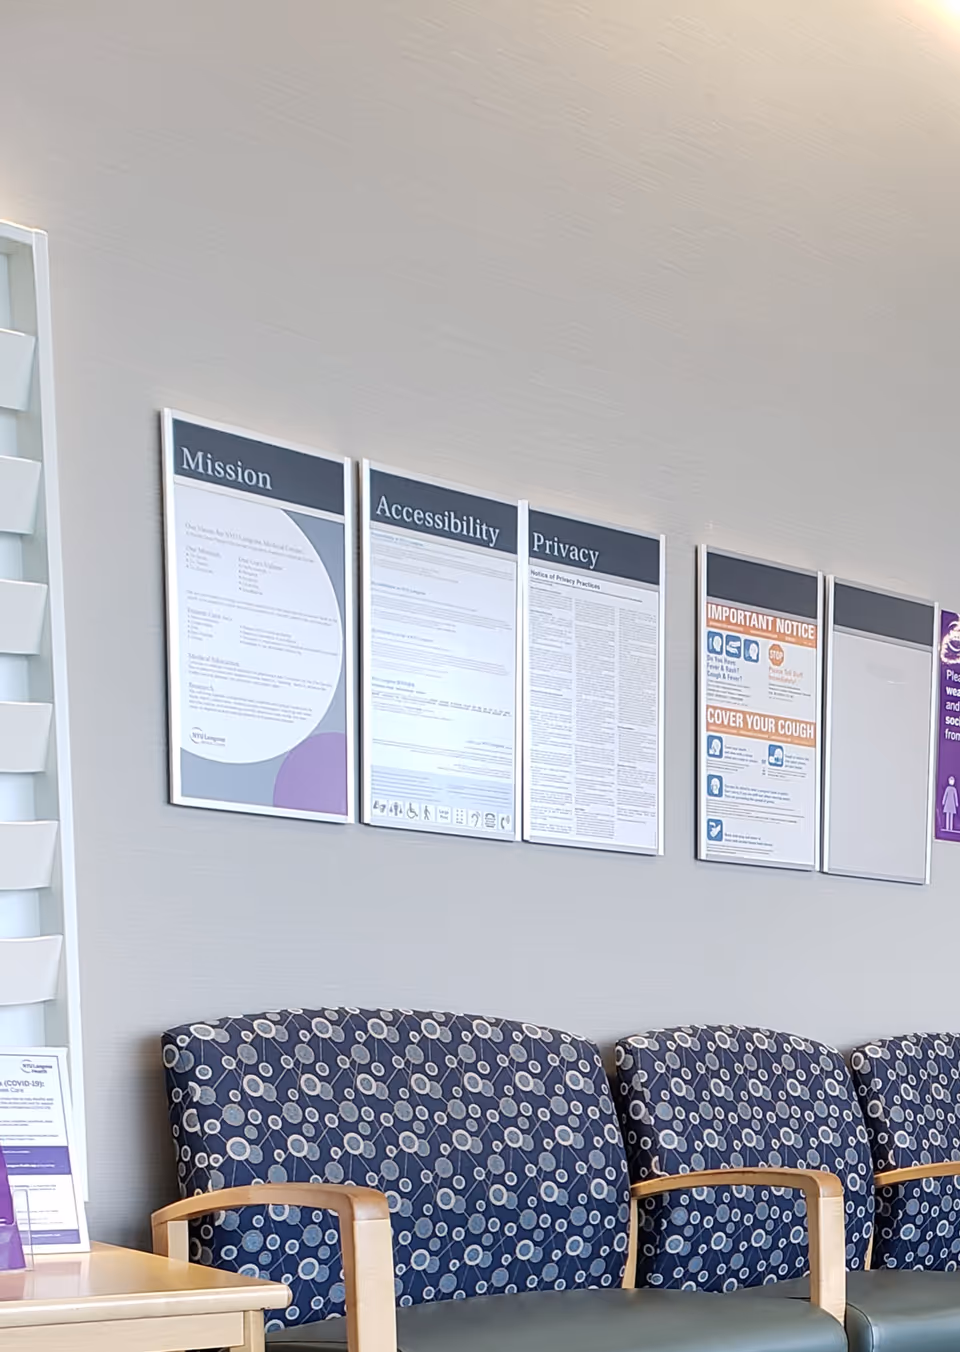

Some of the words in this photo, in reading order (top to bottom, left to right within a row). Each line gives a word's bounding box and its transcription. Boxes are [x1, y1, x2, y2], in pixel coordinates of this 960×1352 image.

[181, 446, 273, 490] Mission
[376, 495, 500, 547] Accessibility
[532, 532, 599, 569] Privacy
[530, 569, 548, 580] Notice
[549, 573, 556, 581] of
[556, 574, 576, 586] Privacy
[576, 579, 601, 590] Practices
[707, 603, 774, 631] IMPORTANT
[776, 619, 815, 639] NOTICE
[769, 650, 784, 660] STOP
[946, 701, 960, 712] and
[707, 708, 743, 728] COVER
[746, 714, 776, 733] YOUR
[778, 720, 814, 739] COUGH
[4, 1079, 45, 1089] (COVID-19):
